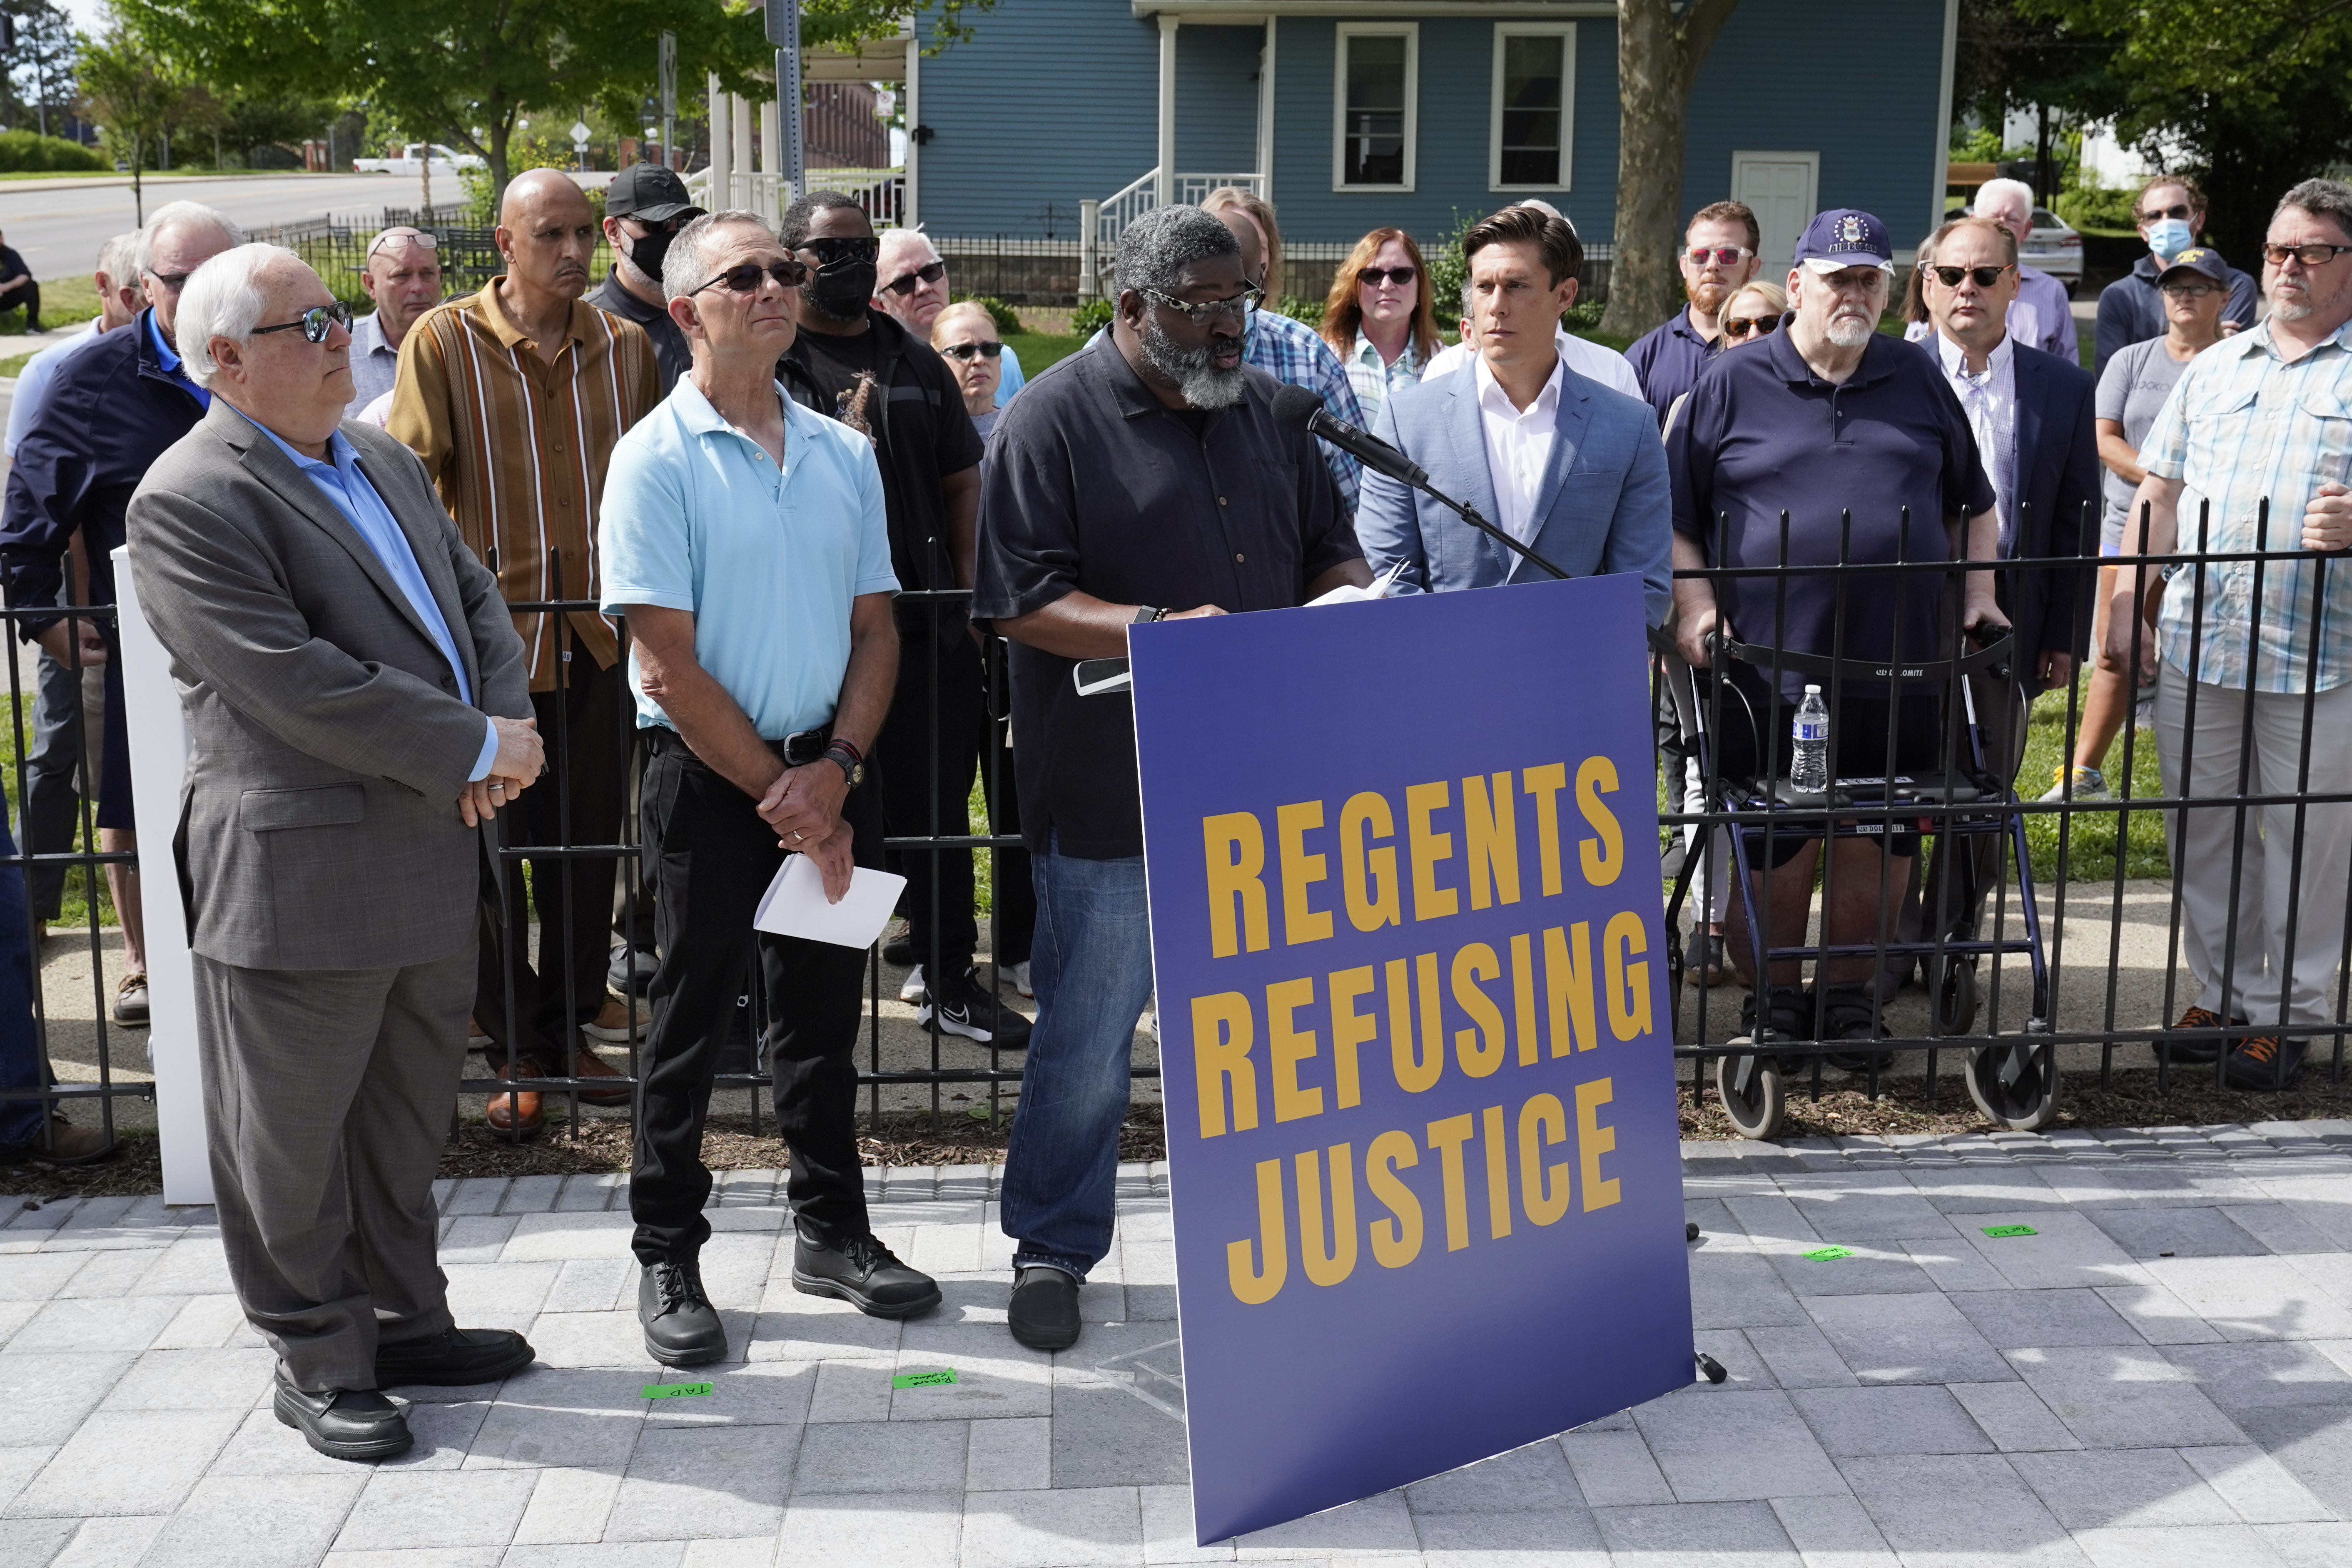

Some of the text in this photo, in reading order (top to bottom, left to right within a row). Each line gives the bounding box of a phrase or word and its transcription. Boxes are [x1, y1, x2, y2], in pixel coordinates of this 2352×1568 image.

[1203, 756, 1623, 958] REGENTS
[1192, 912, 1652, 1138] REFUSING
[1228, 1077, 1620, 1304] JUSTICE
[670, 1385, 709, 1396] TAD
